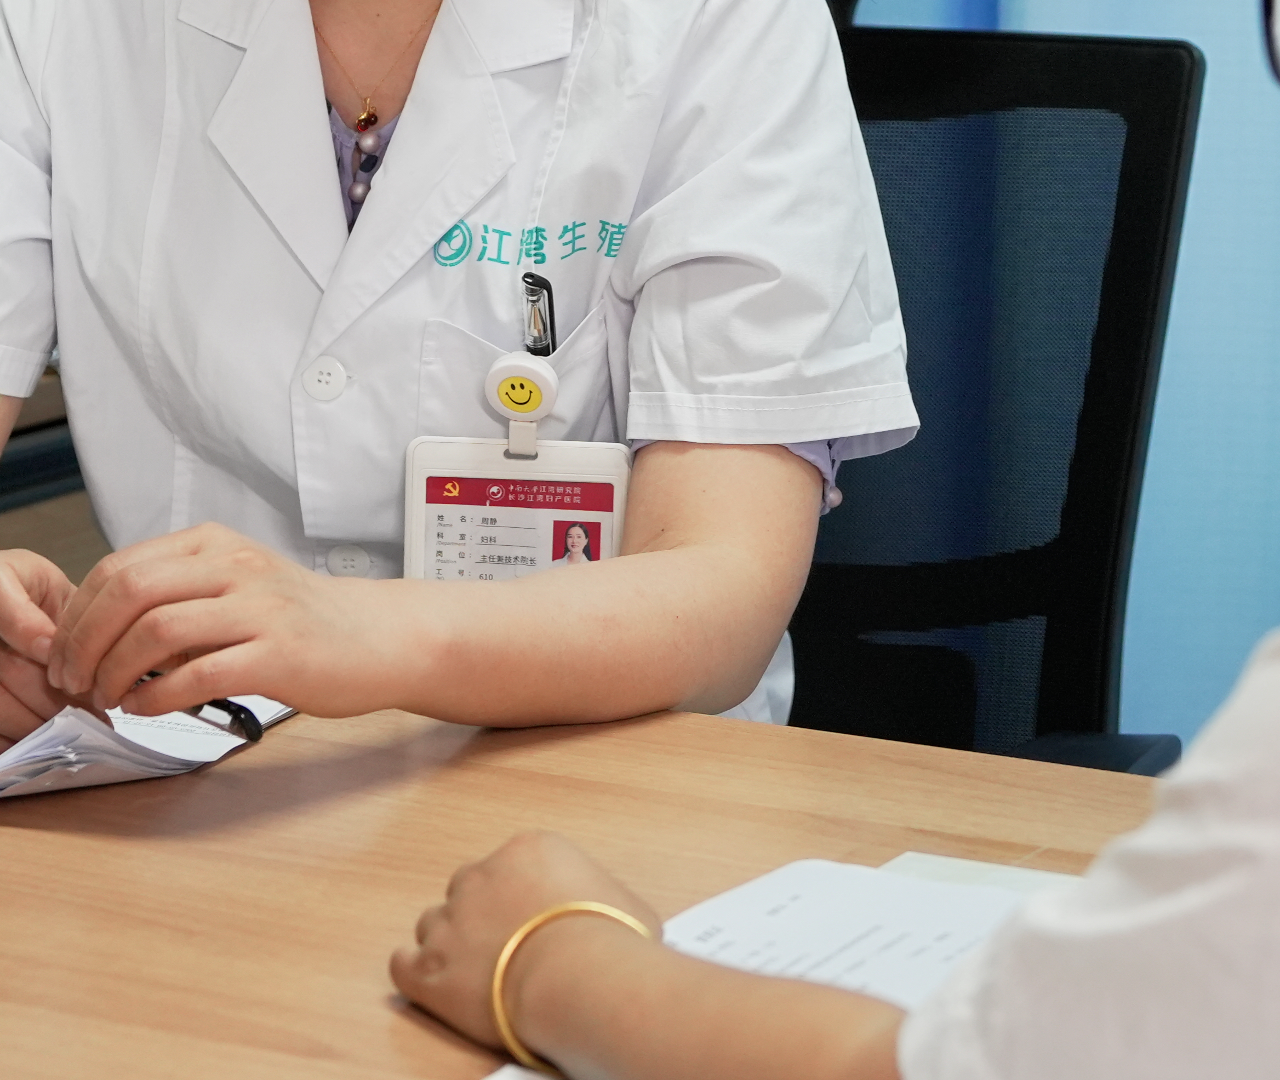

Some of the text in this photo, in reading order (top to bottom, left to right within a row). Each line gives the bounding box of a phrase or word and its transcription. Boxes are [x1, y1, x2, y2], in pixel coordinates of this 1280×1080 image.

[476, 219, 627, 266] 江湾生殖
[508, 493, 581, 504] 长沙江湾妇产医院
[480, 536, 497, 544] 妇科
[479, 573, 494, 581] 610
